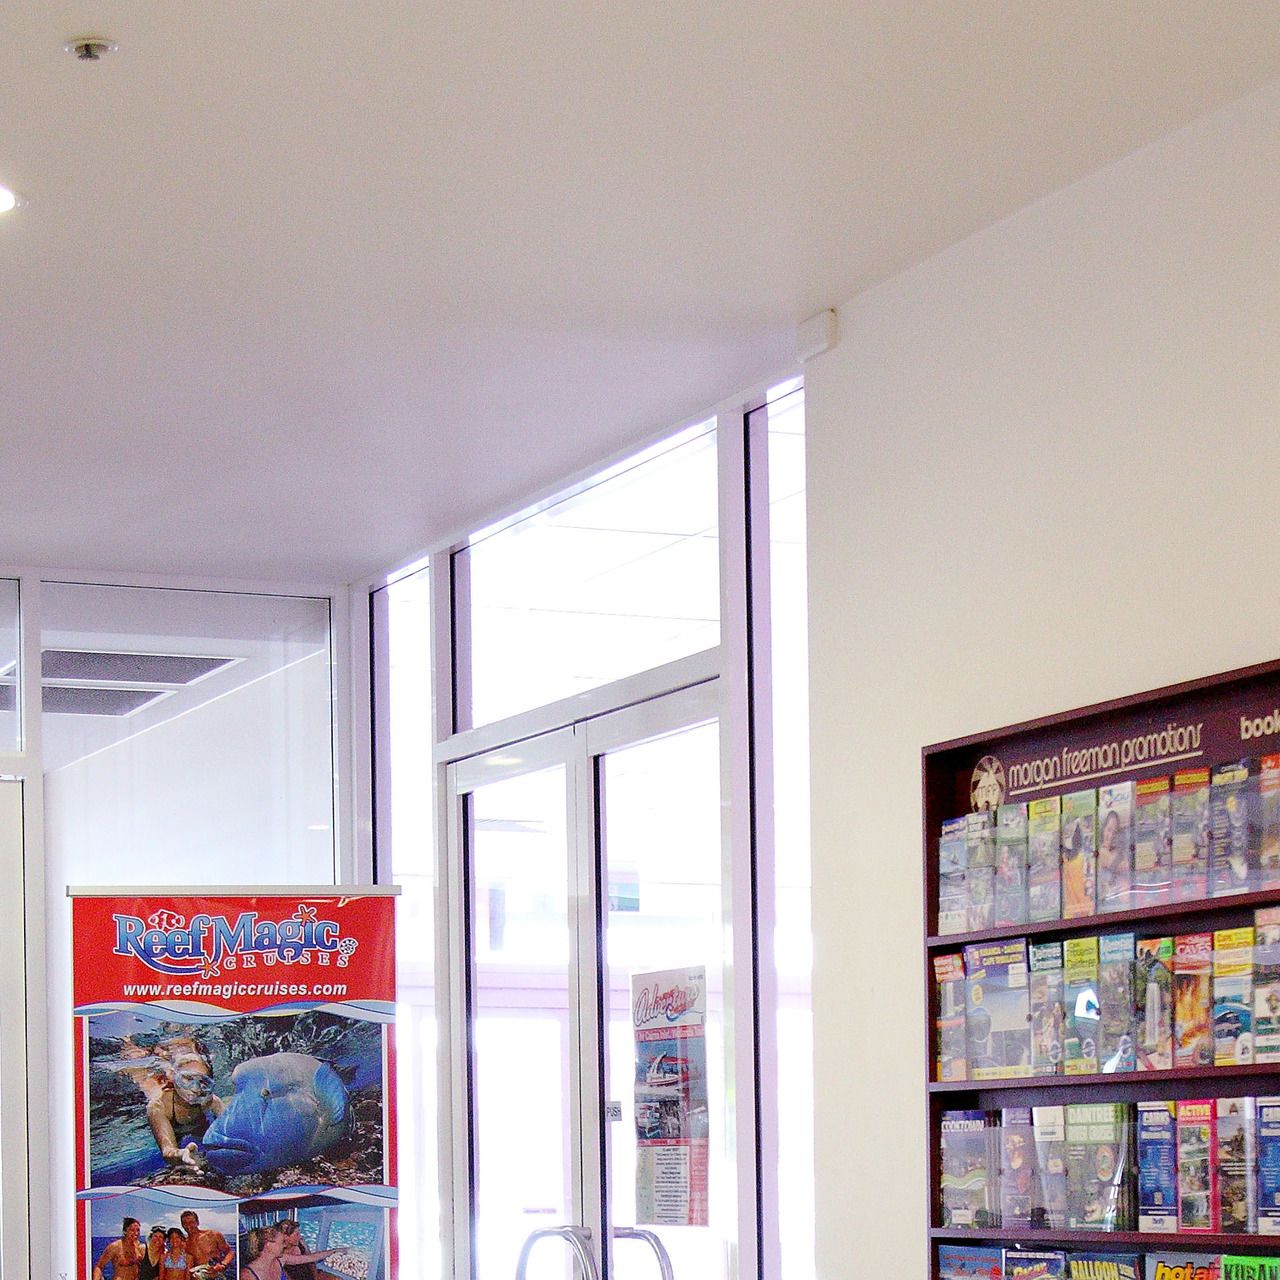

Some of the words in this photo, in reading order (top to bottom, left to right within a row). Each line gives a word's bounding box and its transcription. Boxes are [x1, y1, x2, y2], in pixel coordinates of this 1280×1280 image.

[1008, 755, 1062, 789] morgan
[1062, 743, 1120, 777] freeman
[1121, 722, 1204, 769] promotions
[112, 911, 215, 974] Reef
[211, 908, 342, 964] Magic
[223, 951, 350, 971] CRUISES
[122, 981, 348, 999] www.reefmagiccruises.com
